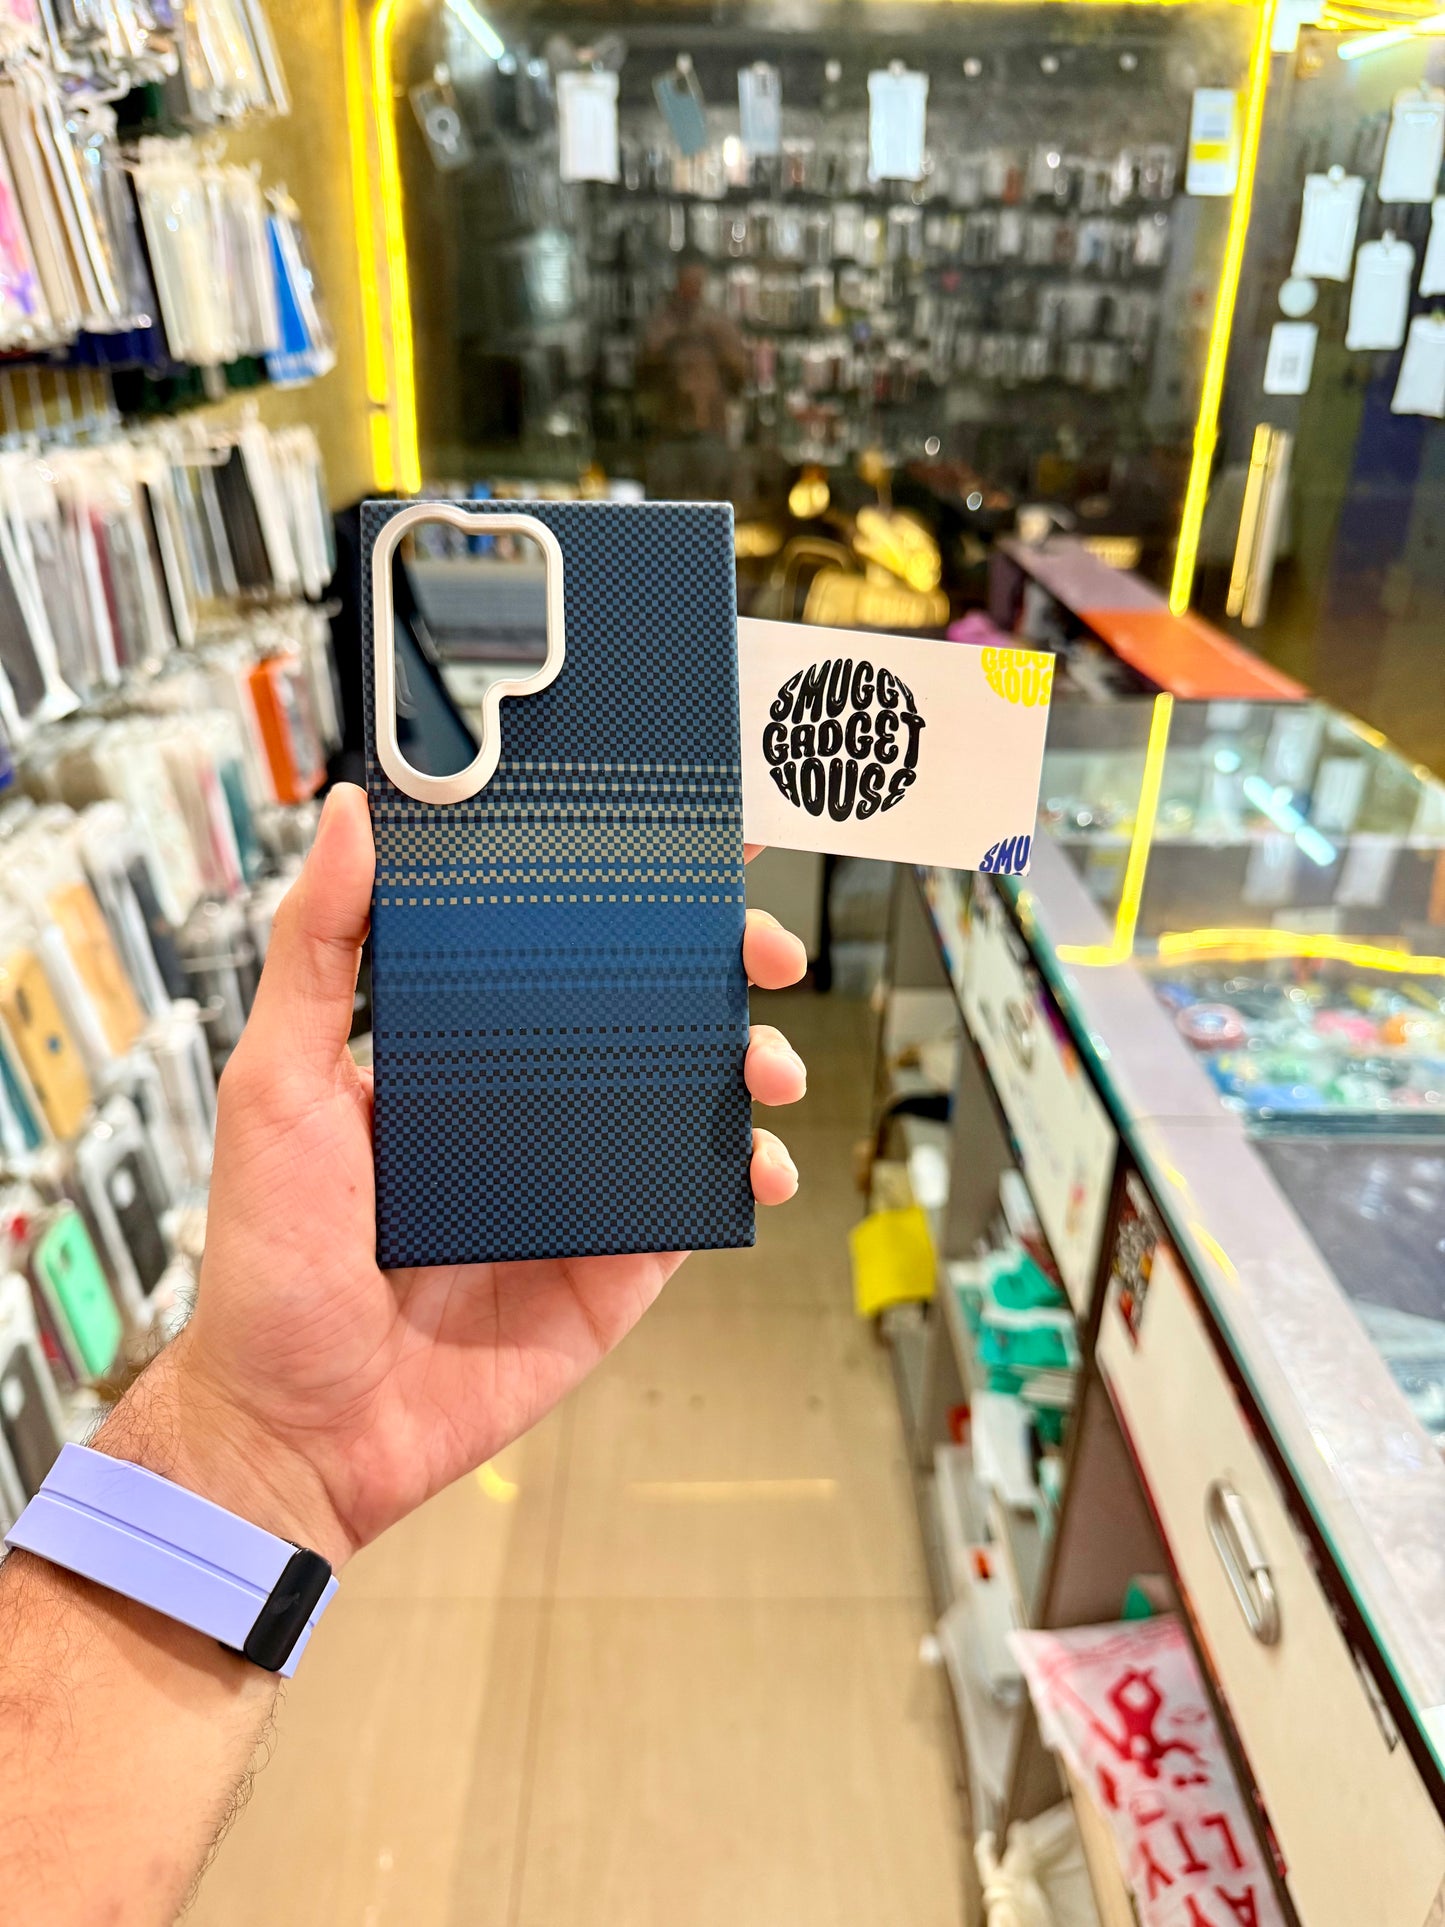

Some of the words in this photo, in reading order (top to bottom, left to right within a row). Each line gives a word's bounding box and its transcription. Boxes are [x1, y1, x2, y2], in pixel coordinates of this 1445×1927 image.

[769, 658, 918, 724] SMUGGY
[981, 646, 1055, 673] GADG
[762, 709, 926, 770] GADGET
[769, 757, 917, 822] HOUSE
